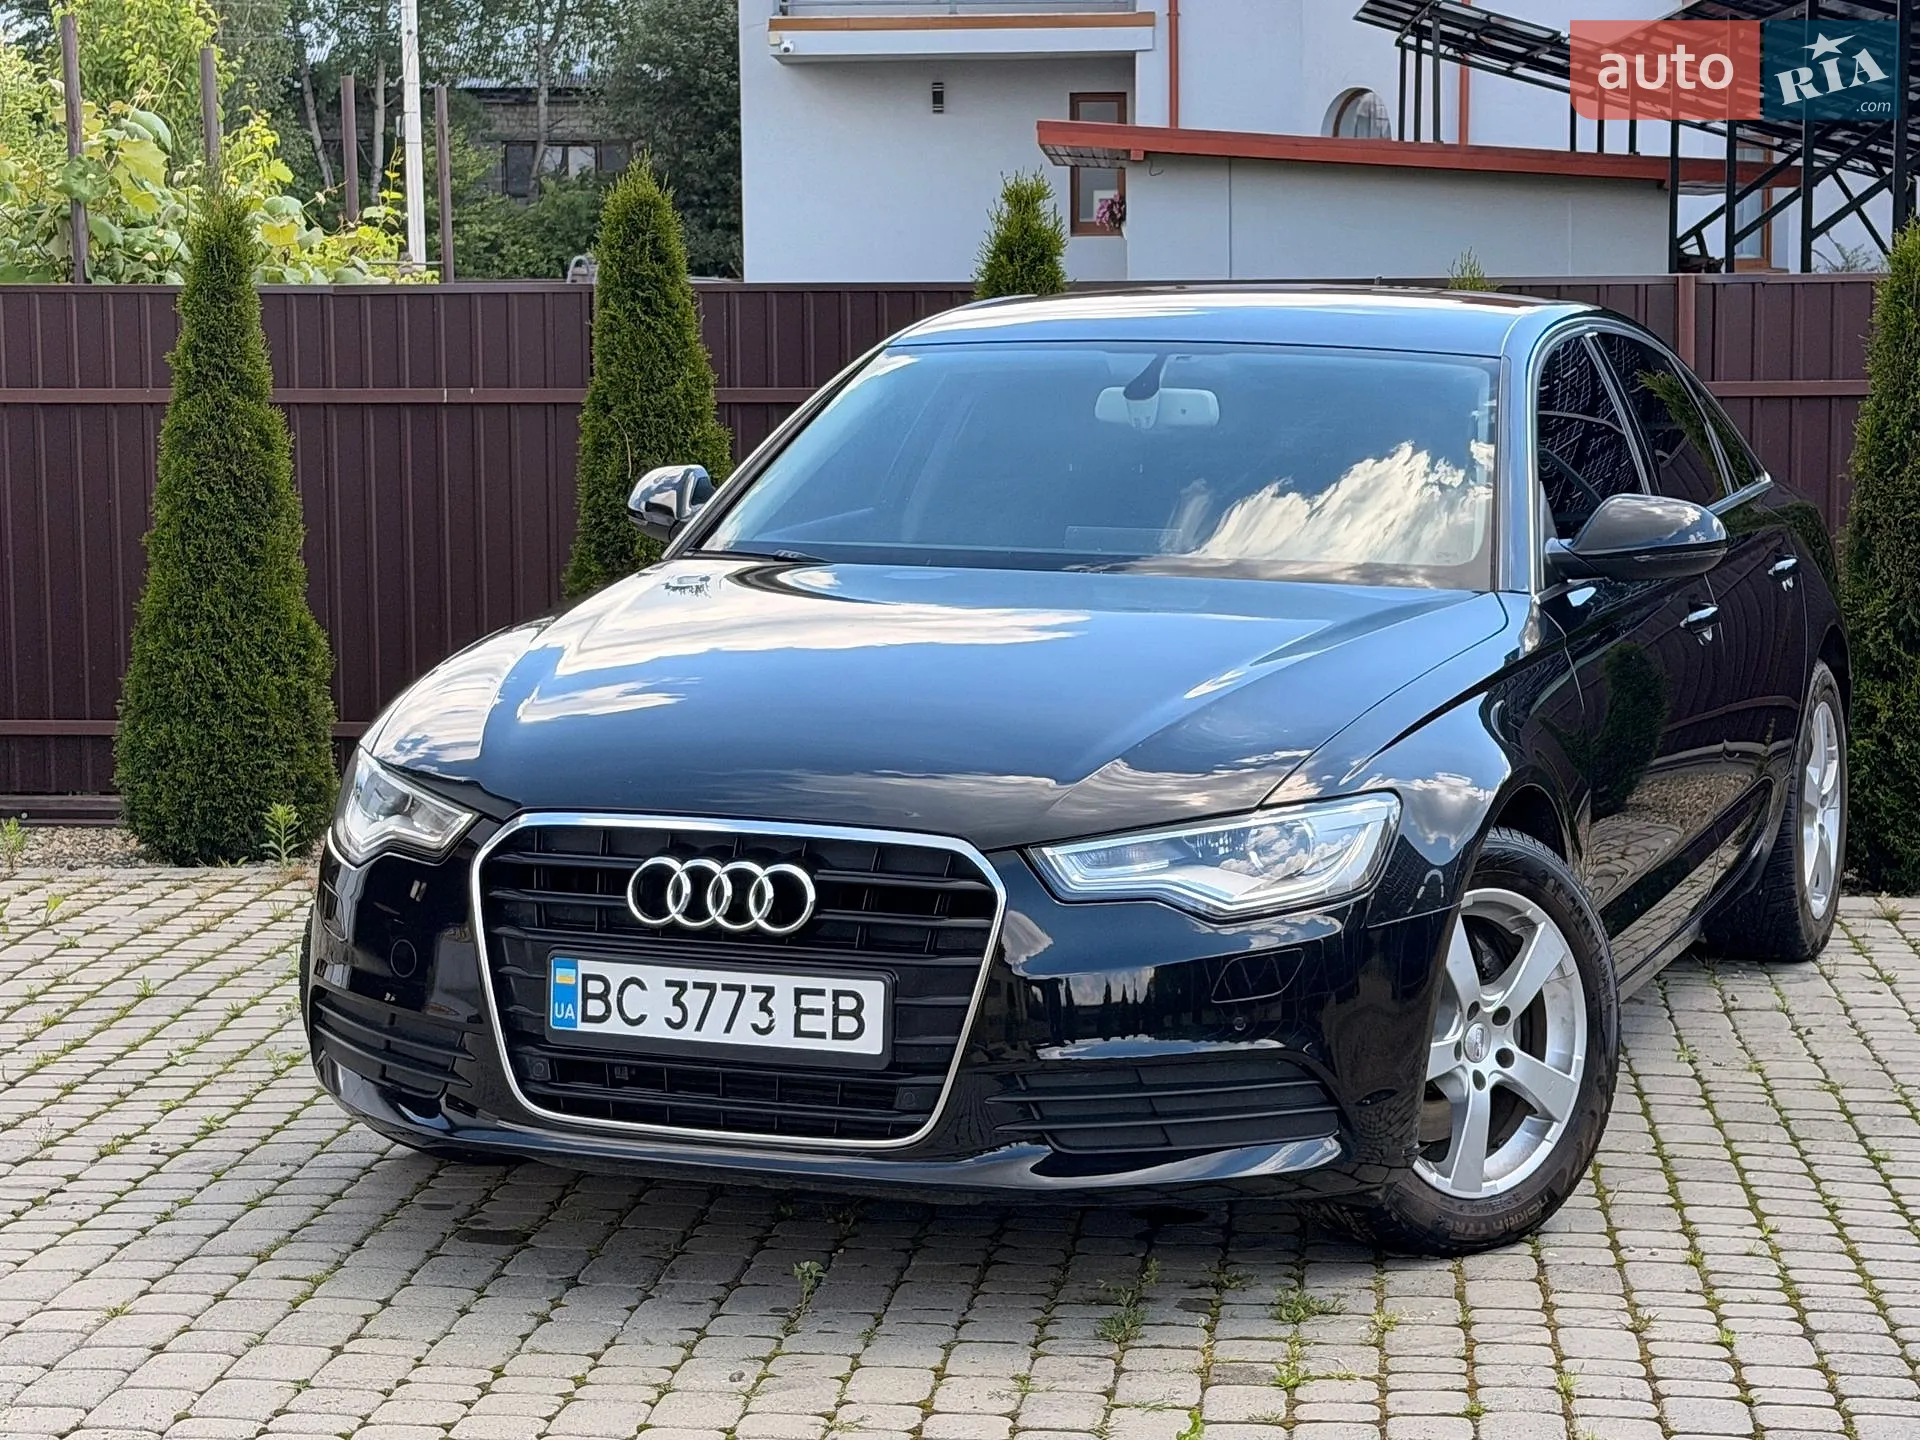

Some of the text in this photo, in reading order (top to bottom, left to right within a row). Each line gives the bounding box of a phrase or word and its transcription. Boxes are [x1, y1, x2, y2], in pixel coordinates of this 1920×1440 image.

[553, 1001, 576, 1020] UA
[580, 972, 867, 1042] BC 3773 EB
